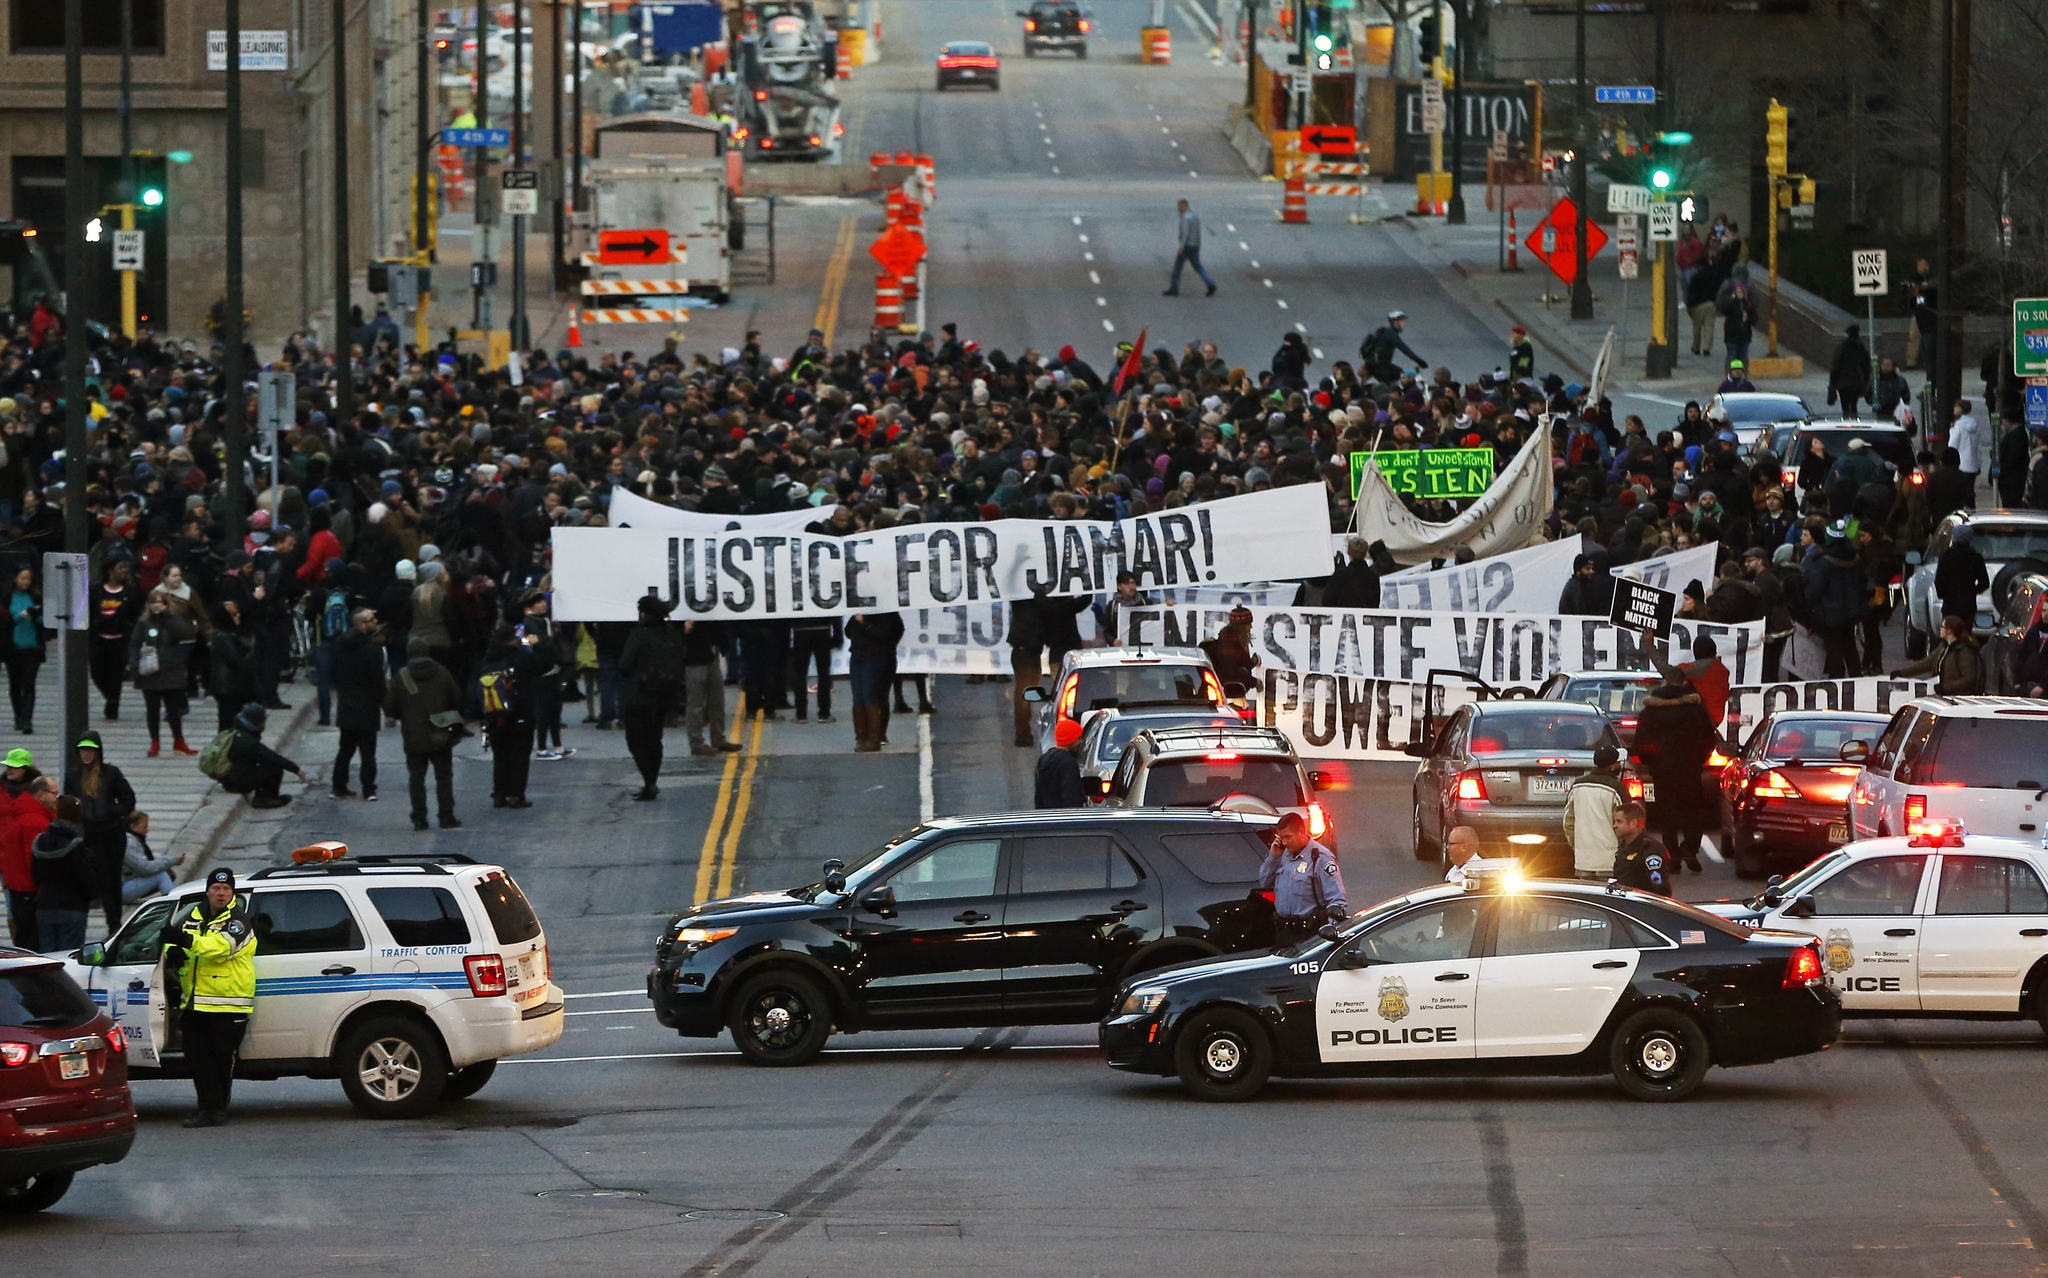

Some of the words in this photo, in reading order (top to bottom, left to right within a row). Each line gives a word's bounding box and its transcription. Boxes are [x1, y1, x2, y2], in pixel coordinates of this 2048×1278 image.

[1603, 87, 1609, 99] S
[1406, 94, 1528, 137] EITION
[1652, 205, 1673, 215] ONE
[1652, 216, 1672, 226] WAY
[1858, 254, 1882, 265] ONE
[1857, 265, 1882, 277] WAY
[2017, 310, 2029, 321] TO
[1393, 453, 1420, 467] don't
[1378, 468, 1488, 493] ISTEN
[648, 536, 876, 613] JUSTICE
[896, 526, 1000, 607] FOR
[1026, 508, 1217, 596] JAMAR!
[1631, 586, 1660, 604] BLACK
[1631, 599, 1656, 616] LIVES
[1624, 610, 1658, 630] MATTER
[381, 947, 418, 957] TRAFFIC
[426, 946, 468, 955] CONTROL
[1289, 961, 1318, 975] 105
[1331, 1026, 1458, 1046] POLICE
